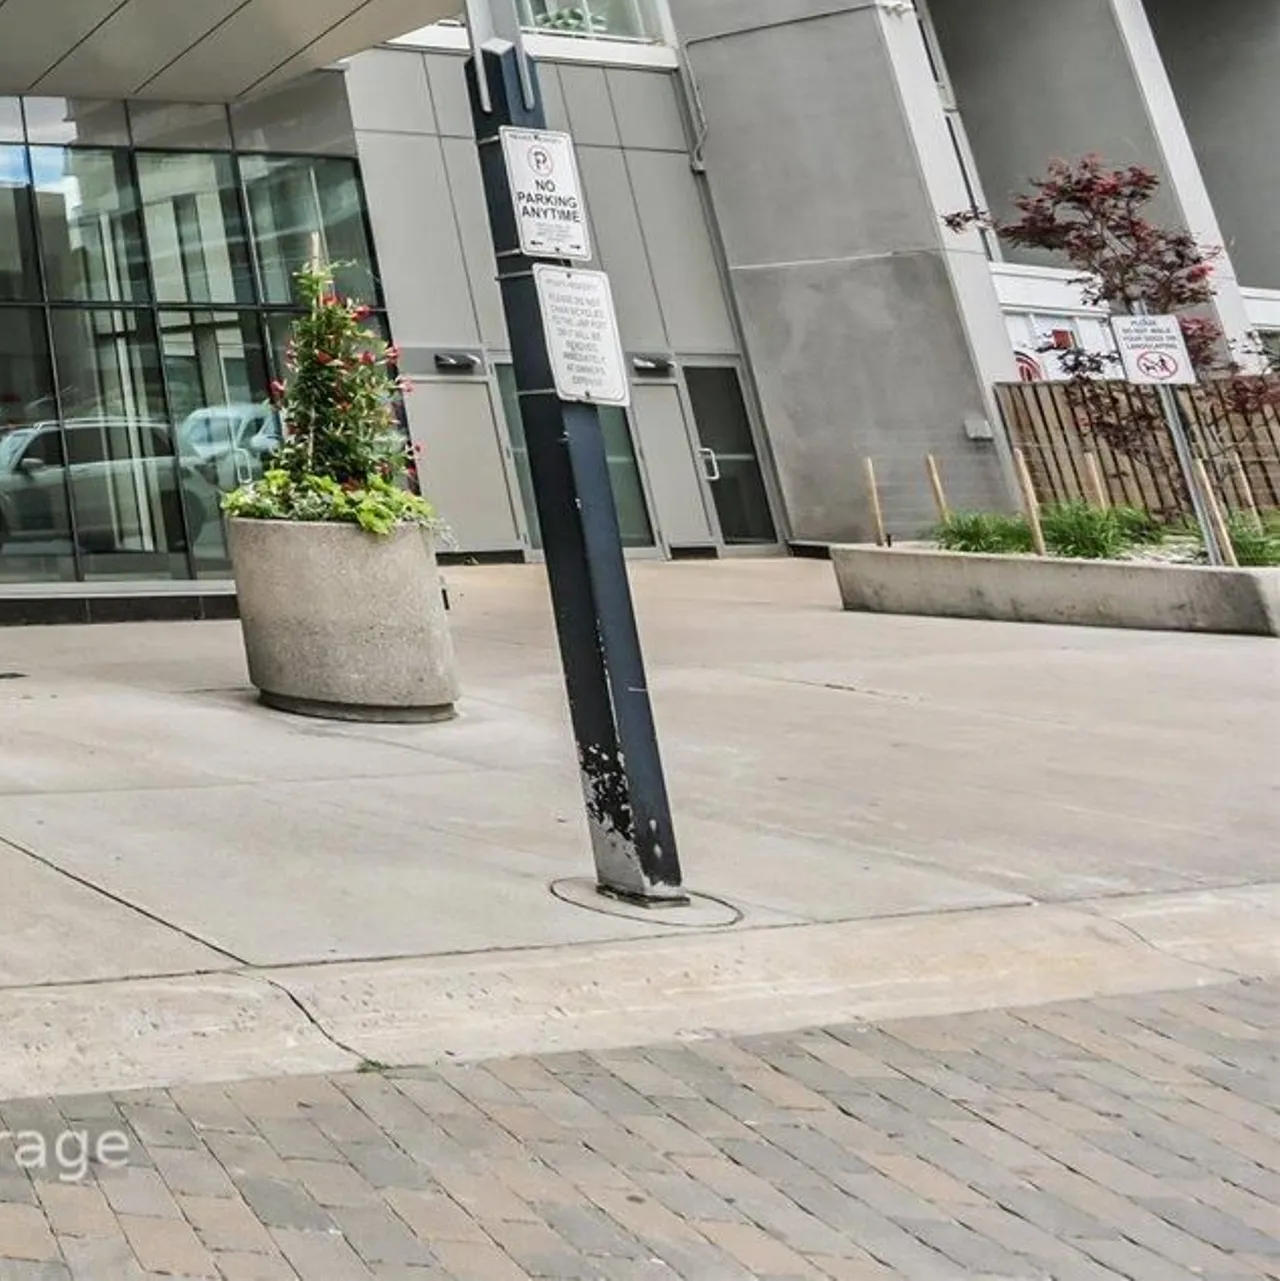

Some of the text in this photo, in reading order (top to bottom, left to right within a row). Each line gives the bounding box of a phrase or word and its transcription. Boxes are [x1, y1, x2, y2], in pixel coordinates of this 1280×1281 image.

[535, 180, 555, 192] NO
[517, 192, 577, 208] PARKING
[522, 206, 580, 222] ANYTIME
